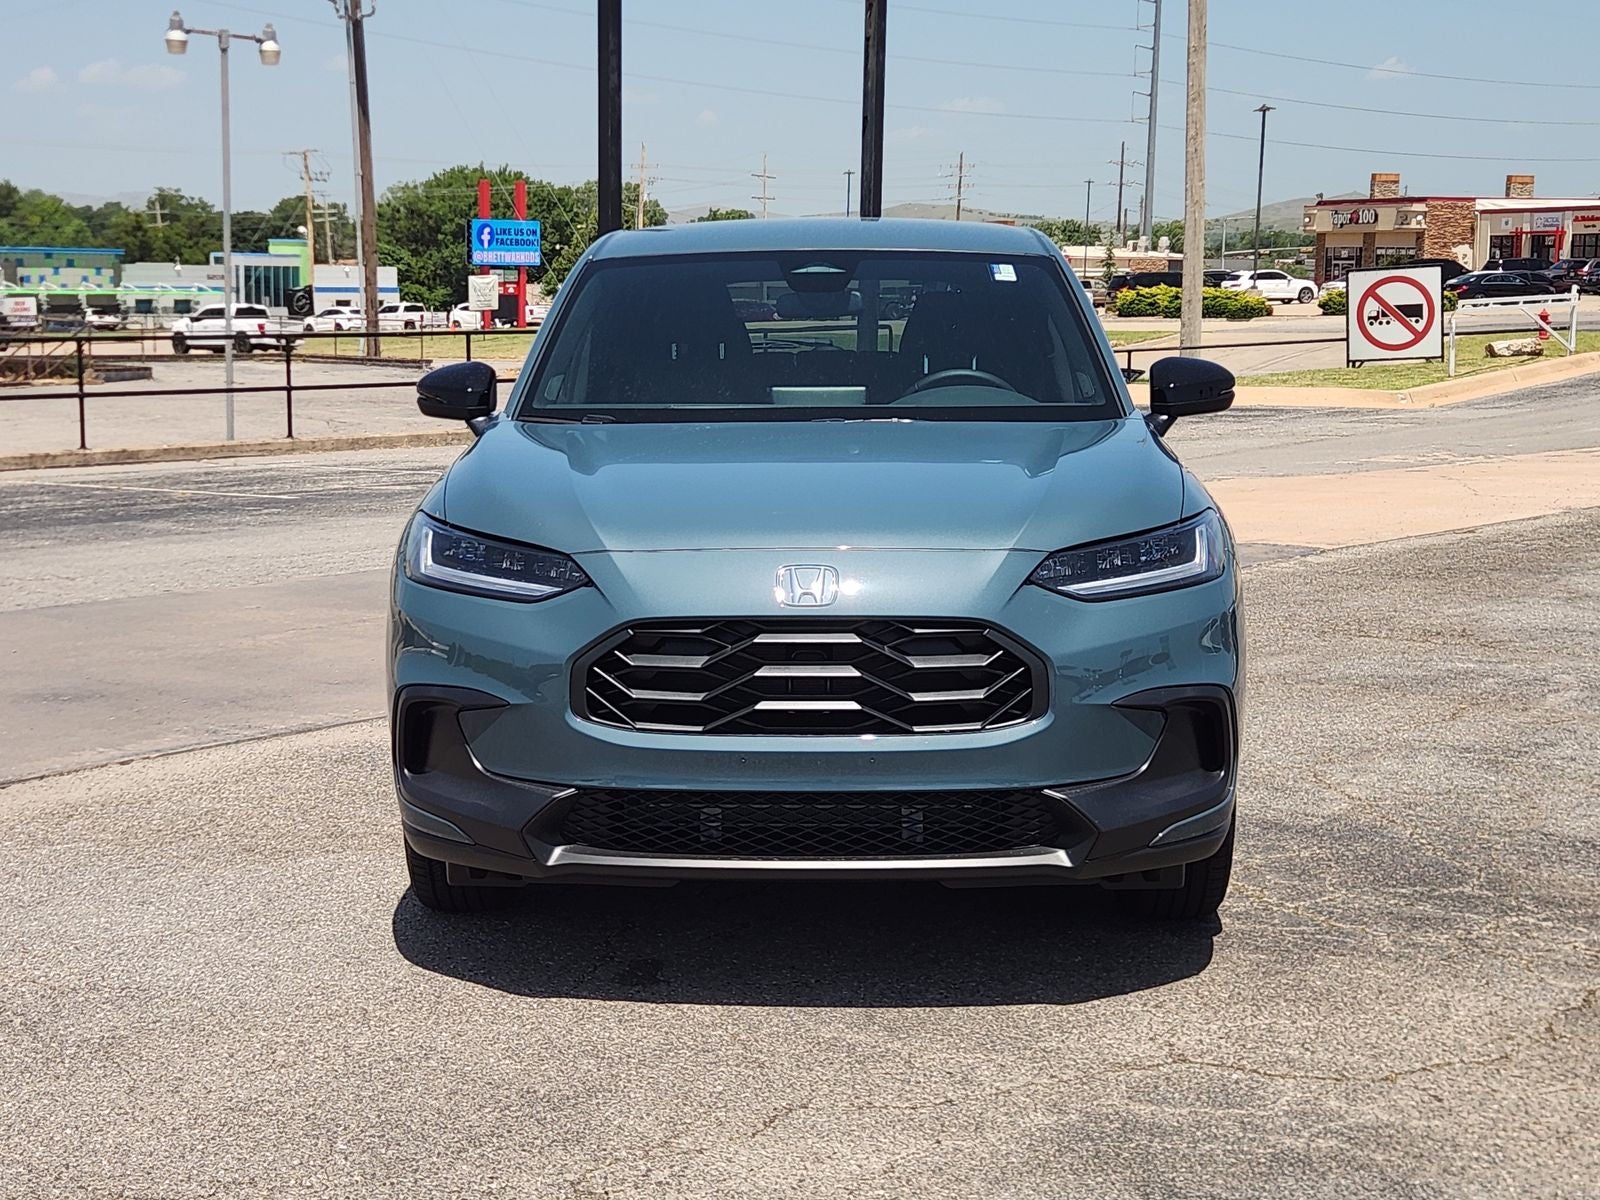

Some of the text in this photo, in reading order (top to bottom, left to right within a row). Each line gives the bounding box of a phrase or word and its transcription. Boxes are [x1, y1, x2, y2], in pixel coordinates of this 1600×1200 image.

[1330, 209, 1376, 228] Vapor 100
[495, 227, 538, 237] LIKE US ON
[495, 238, 539, 247] FACEBOOK!
